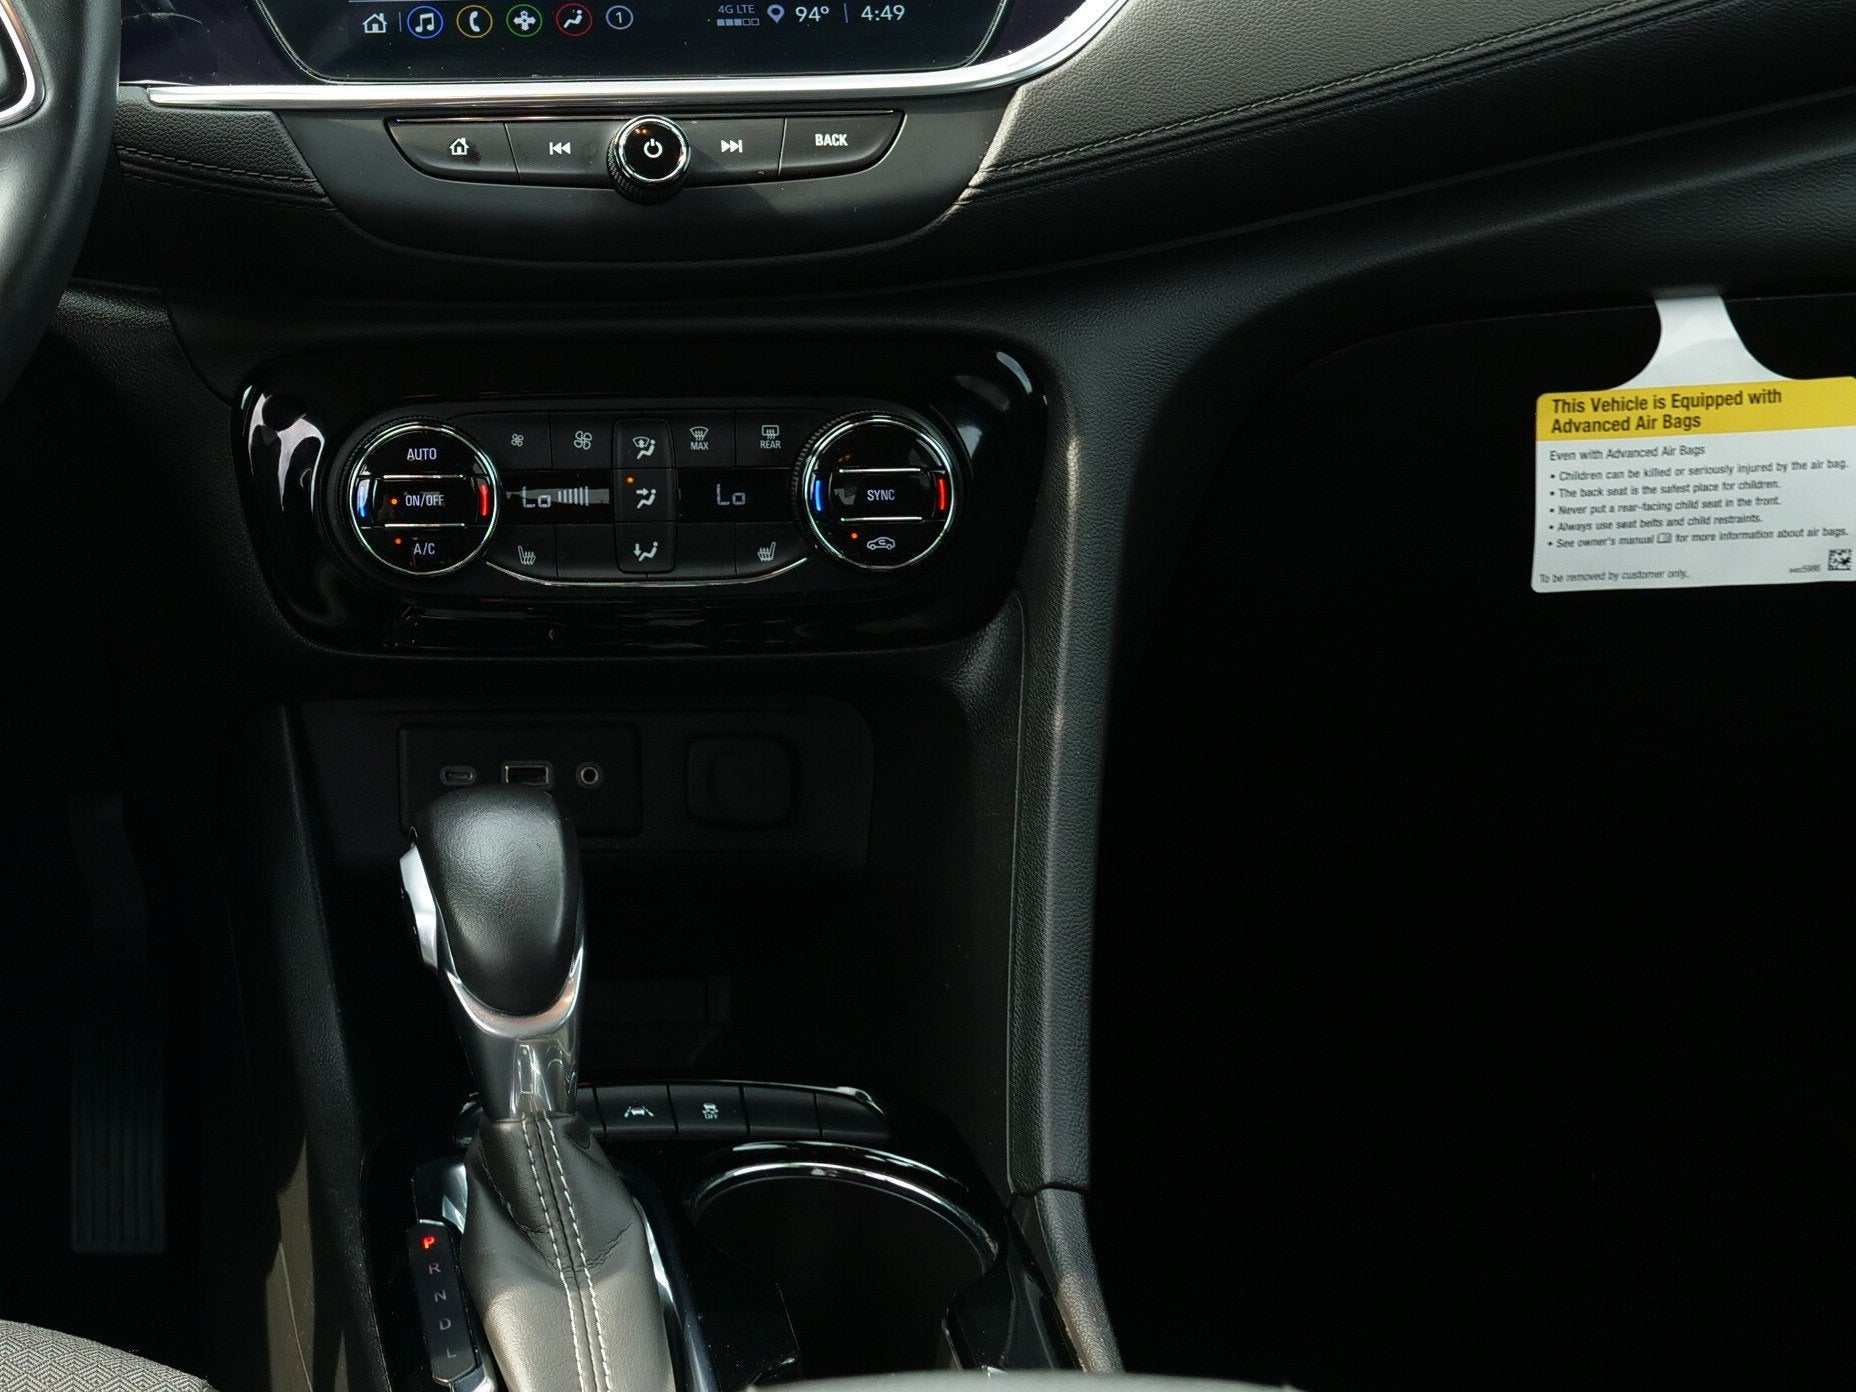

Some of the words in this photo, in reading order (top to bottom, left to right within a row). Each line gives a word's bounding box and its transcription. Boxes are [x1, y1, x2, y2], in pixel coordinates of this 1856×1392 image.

[718, 4, 734, 15] 4G
[736, 4, 755, 14] LTE
[861, 5, 906, 22] 4:49
[815, 133, 848, 148] BACK
[1552, 398, 1586, 414] This
[1590, 396, 1648, 412] Vehicle
[1653, 394, 1667, 409] is
[1671, 391, 1743, 410] Equipped
[1748, 388, 1782, 404] with
[1551, 414, 1630, 434] Advanced
[1635, 414, 1657, 431] Air
[1662, 413, 1702, 431] Bags
[690, 441, 709, 451] MAX
[759, 439, 782, 450] REAR
[406, 447, 437, 461] AUTO
[1549, 450, 1576, 461] Even
[1578, 449, 1604, 460] with
[1605, 446, 1658, 459] Advanced
[1661, 446, 1676, 456] Air
[1678, 444, 1706, 456] Bags
[1558, 471, 1603, 481] Children
[521, 485, 552, 509] Lo
[716, 483, 746, 506] Lo
[867, 489, 896, 502] SYNC
[1558, 488, 1577, 498] The
[1579, 487, 1604, 497] back
[1606, 486, 1628, 496] seat
[405, 494, 445, 507] ON/OFF
[1558, 505, 1587, 515] Never
[413, 542, 436, 556] A/C
[421, 1235, 436, 1249] P
[428, 1262, 442, 1275] R
[434, 1289, 447, 1302] N
[439, 1318, 452, 1331] D
[446, 1348, 457, 1359] L
